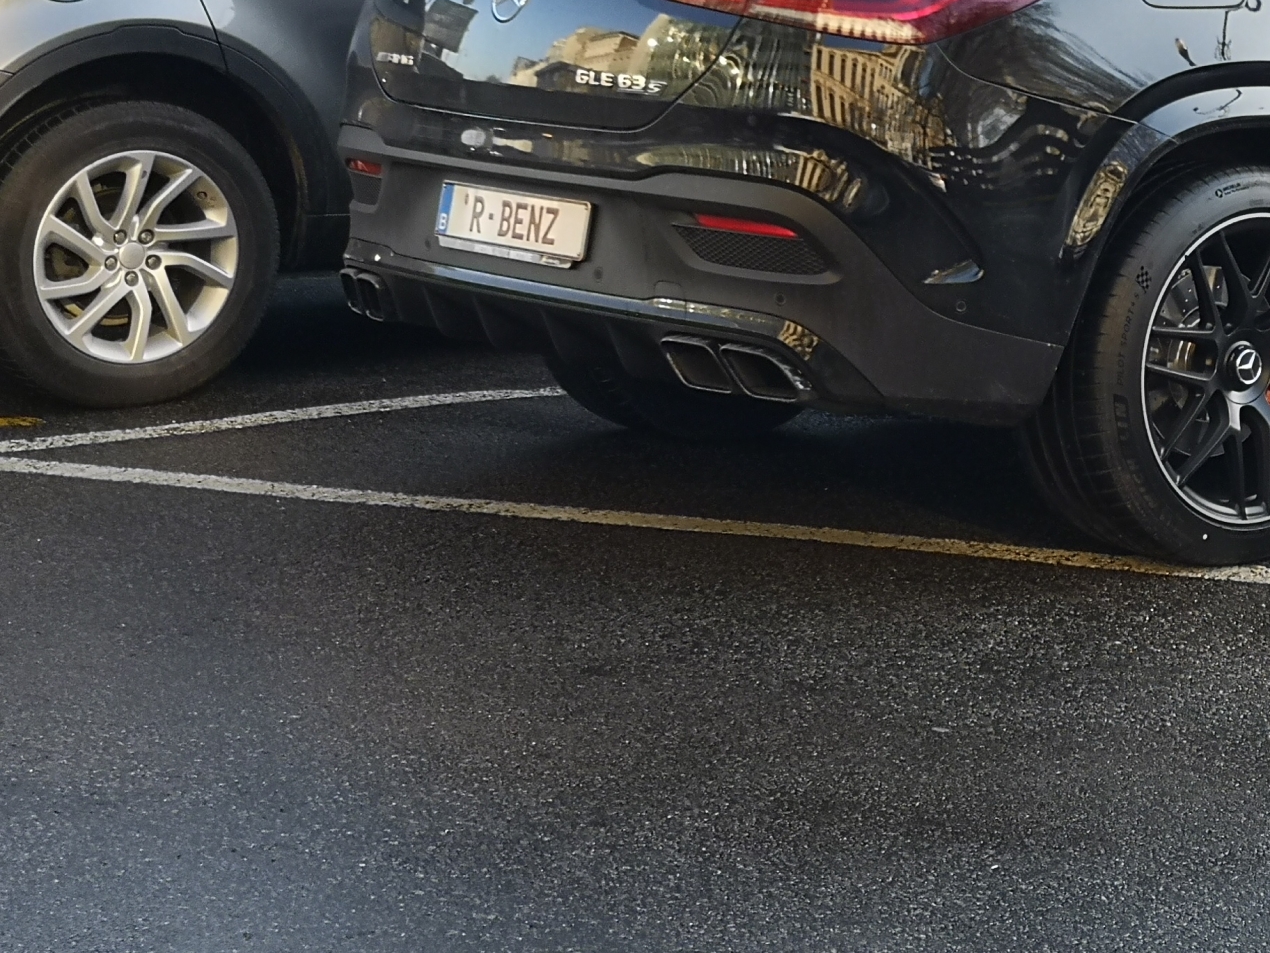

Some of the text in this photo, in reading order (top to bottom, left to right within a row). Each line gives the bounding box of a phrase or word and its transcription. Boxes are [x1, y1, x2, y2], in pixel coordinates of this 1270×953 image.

[575, 68, 615, 87] GLE
[617, 73, 647, 90] 63
[438, 213, 448, 230] B
